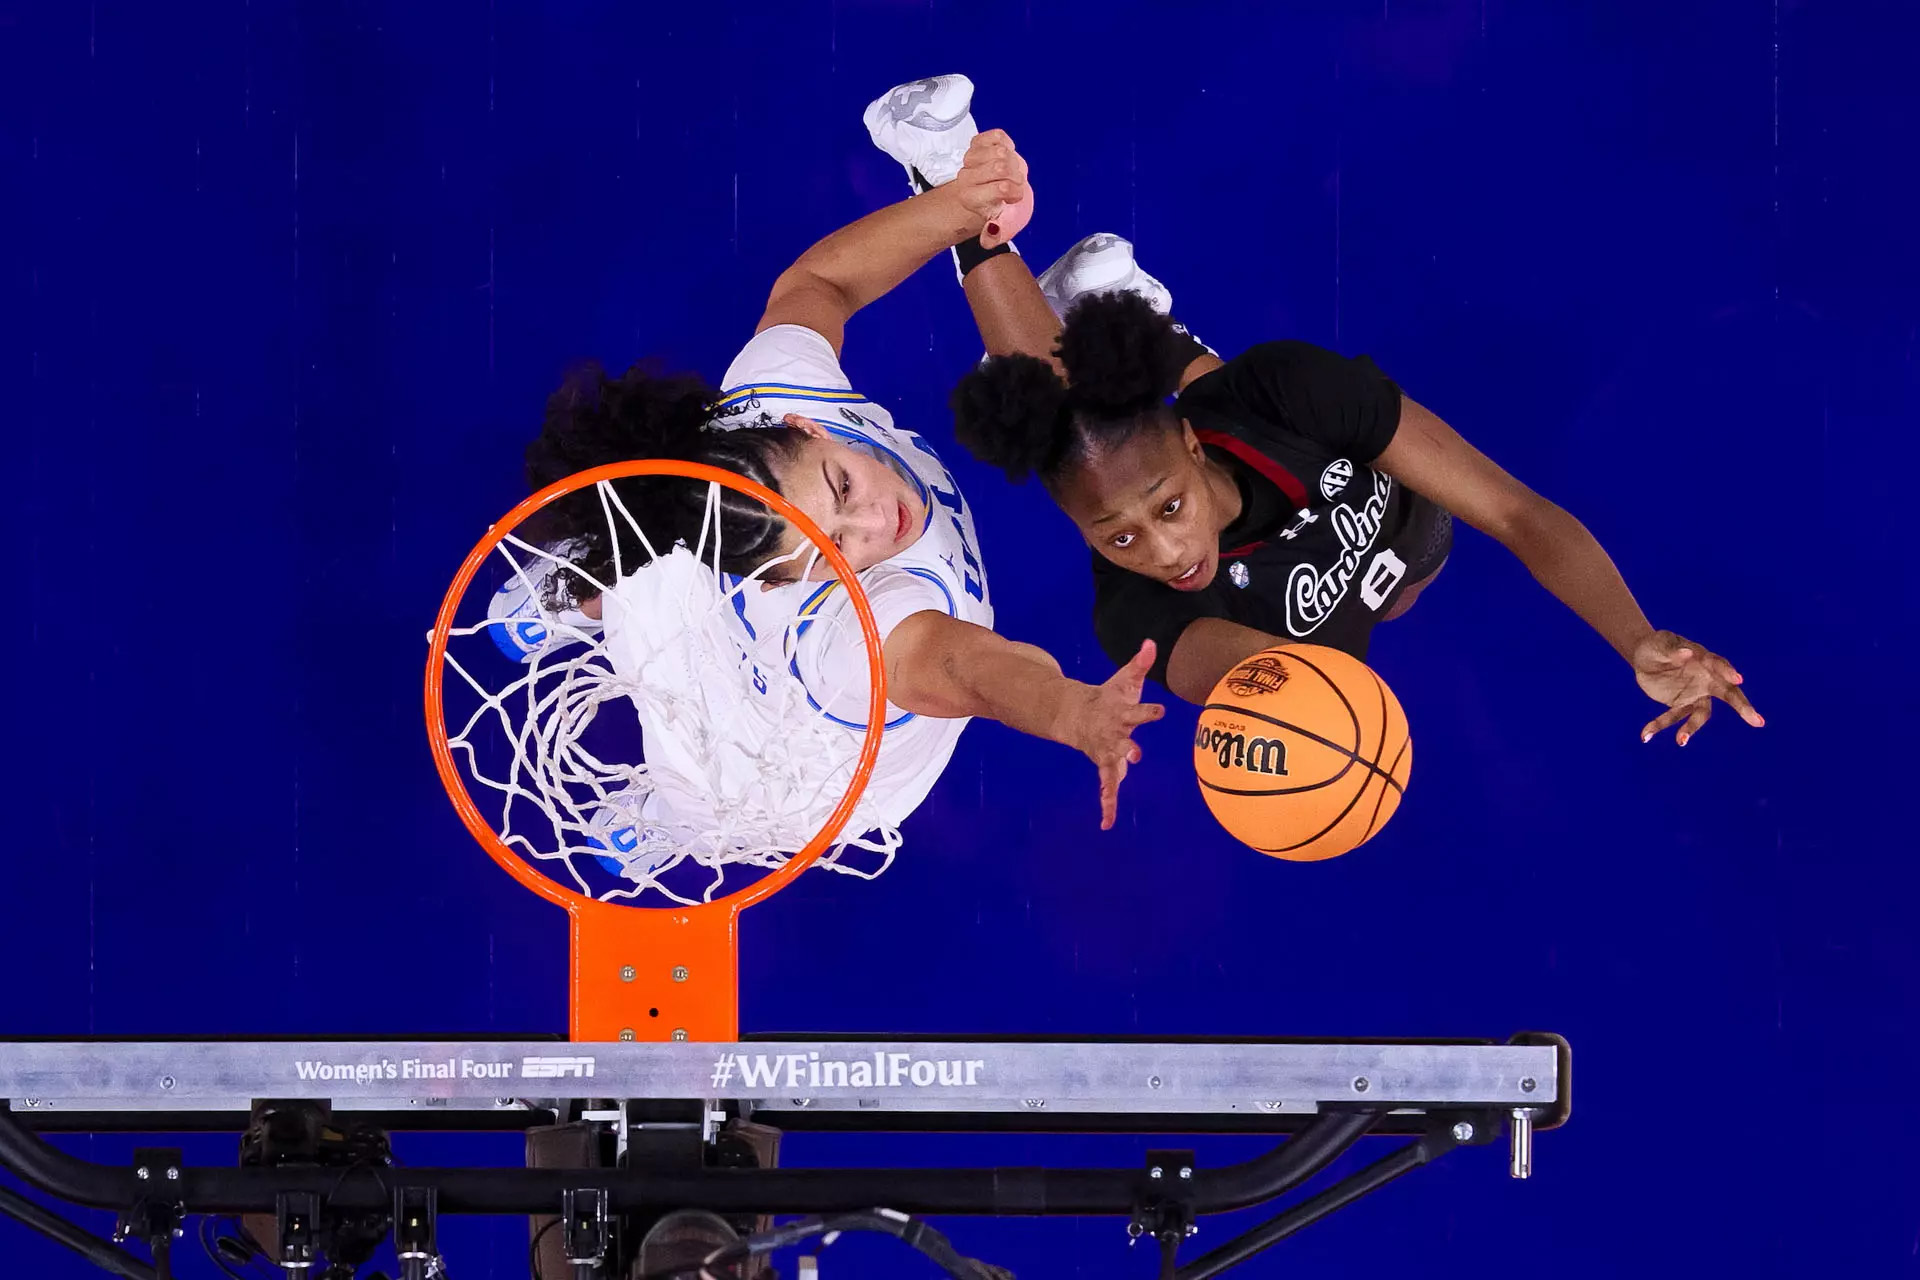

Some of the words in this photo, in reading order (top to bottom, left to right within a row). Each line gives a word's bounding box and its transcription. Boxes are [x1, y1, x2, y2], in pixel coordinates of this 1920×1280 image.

[1320, 459, 1353, 502] SEC
[1286, 469, 1392, 637] Carolina
[402, 1058, 455, 1080] Final
[461, 1060, 513, 1080] Four
[521, 1056, 595, 1078] ESPN
[710, 1051, 985, 1089] #WFinalFour
